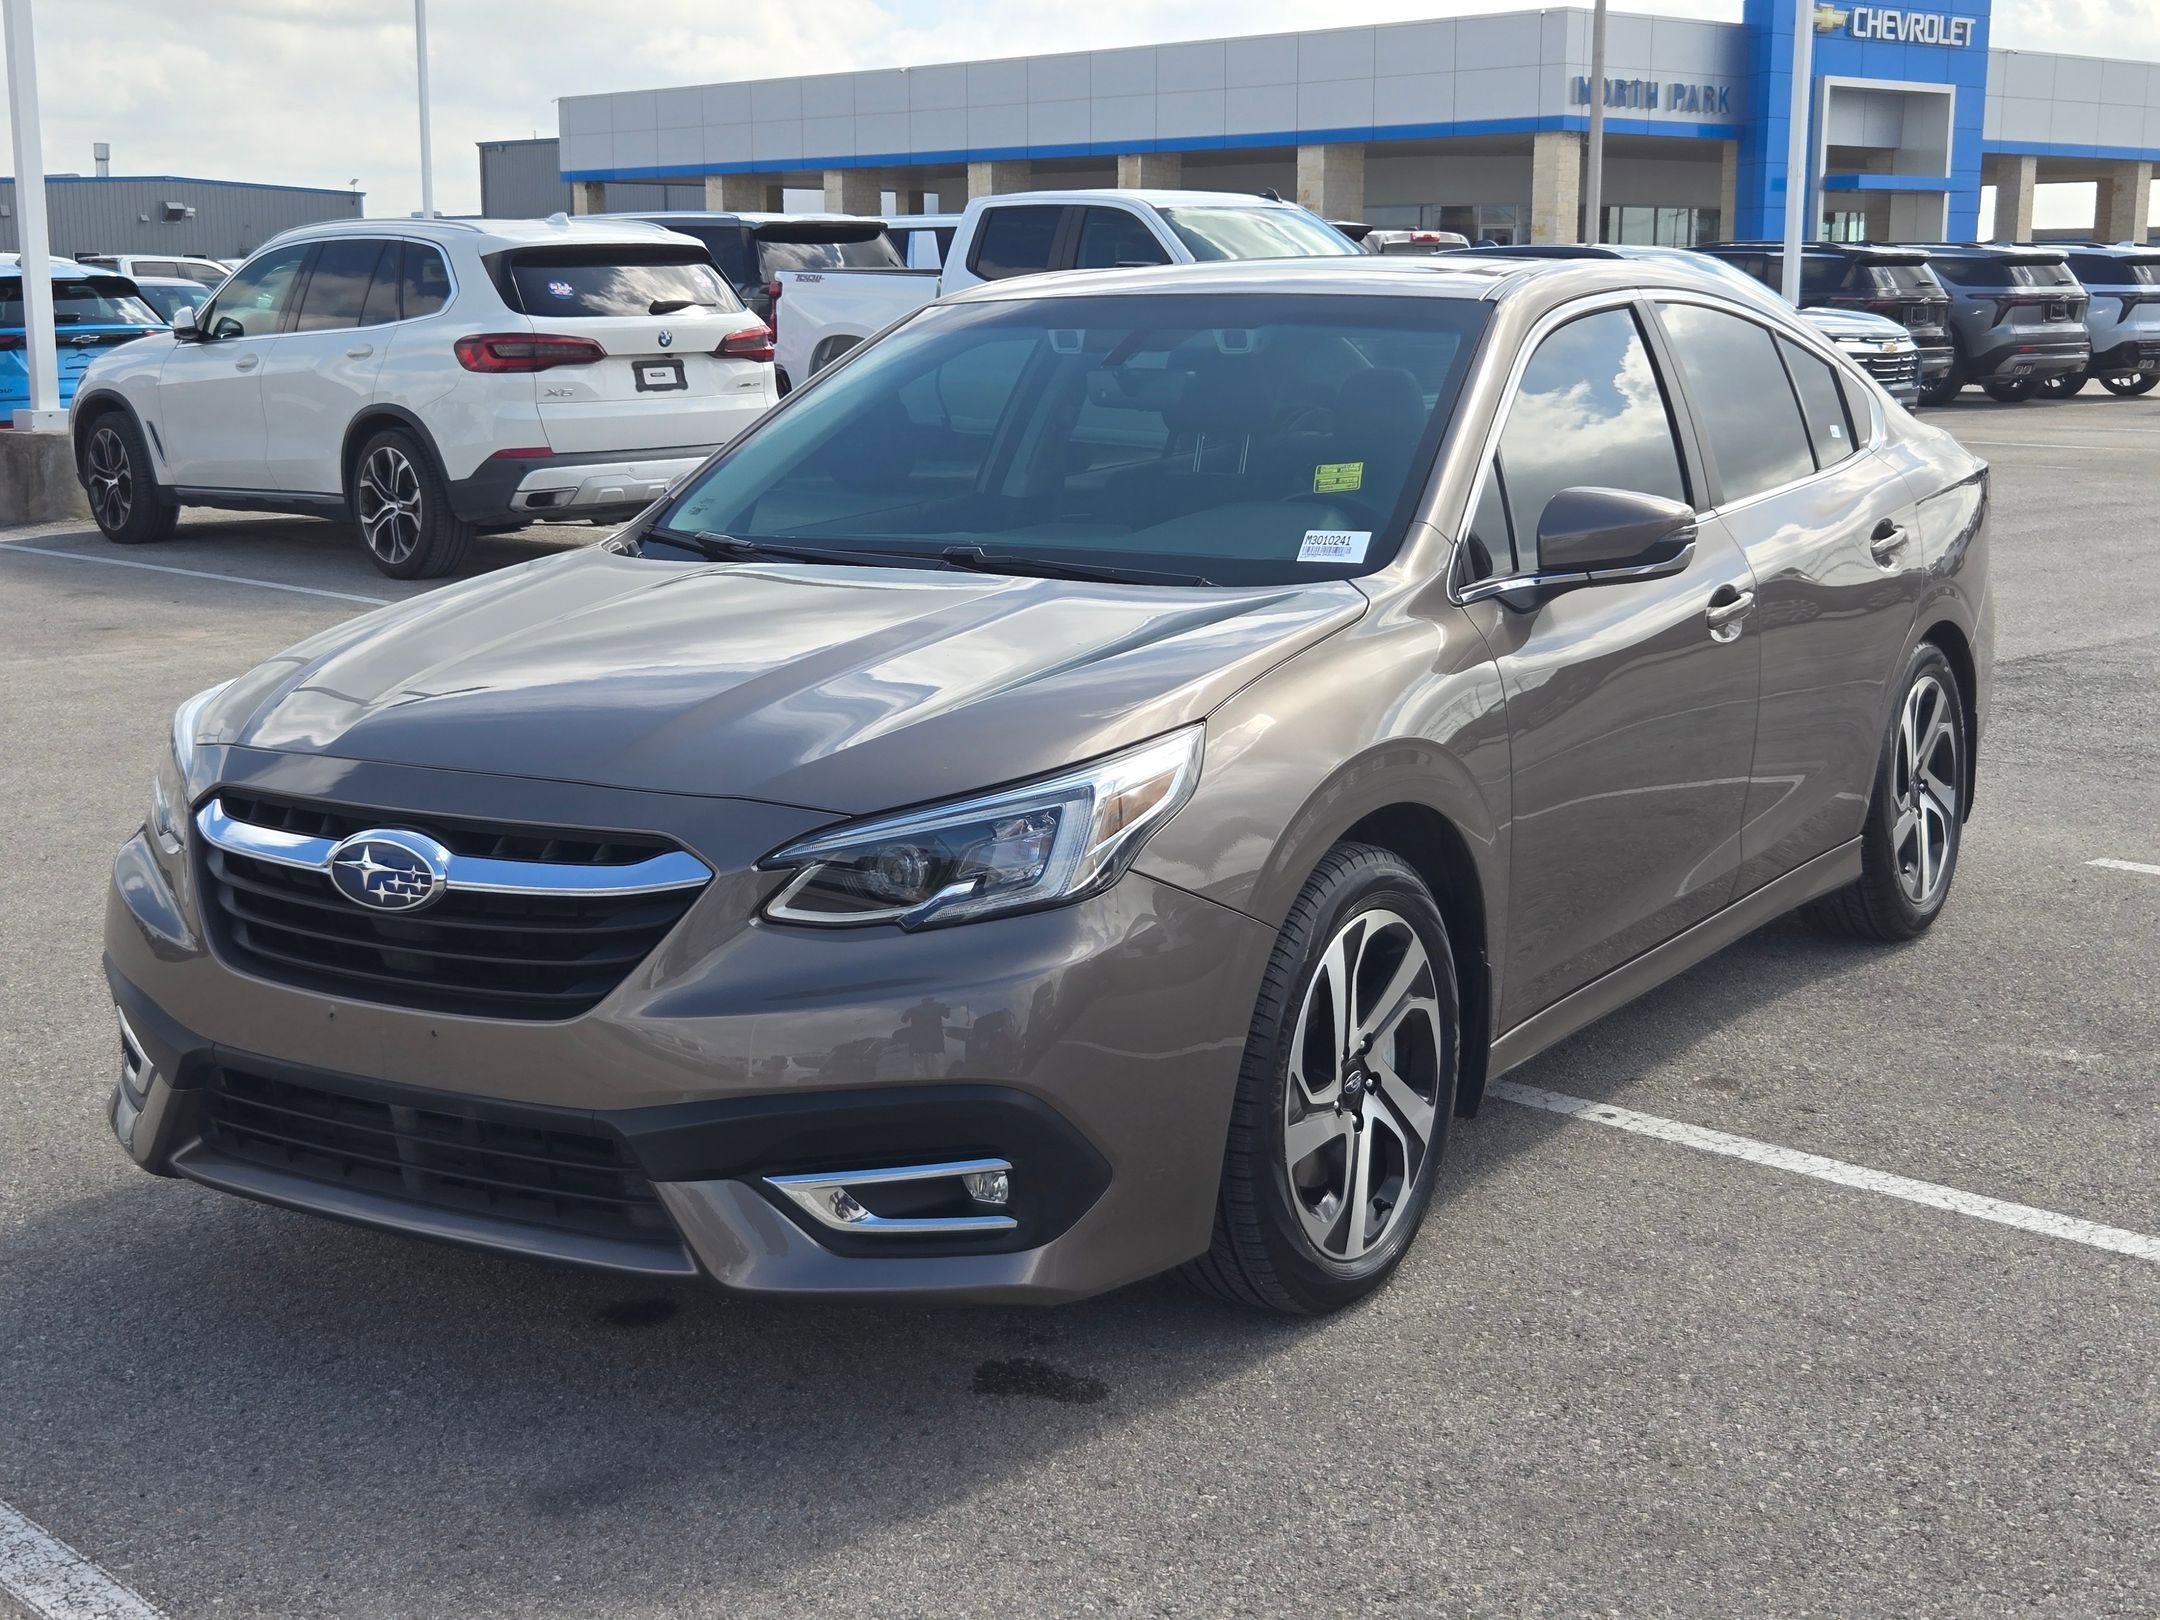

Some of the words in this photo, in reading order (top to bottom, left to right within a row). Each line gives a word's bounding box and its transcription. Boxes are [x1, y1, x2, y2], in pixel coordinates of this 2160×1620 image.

[1852, 7, 1976, 47] CHEVROLET
[1670, 83, 1731, 113] PARK
[1305, 535, 1351, 546] M3010241
